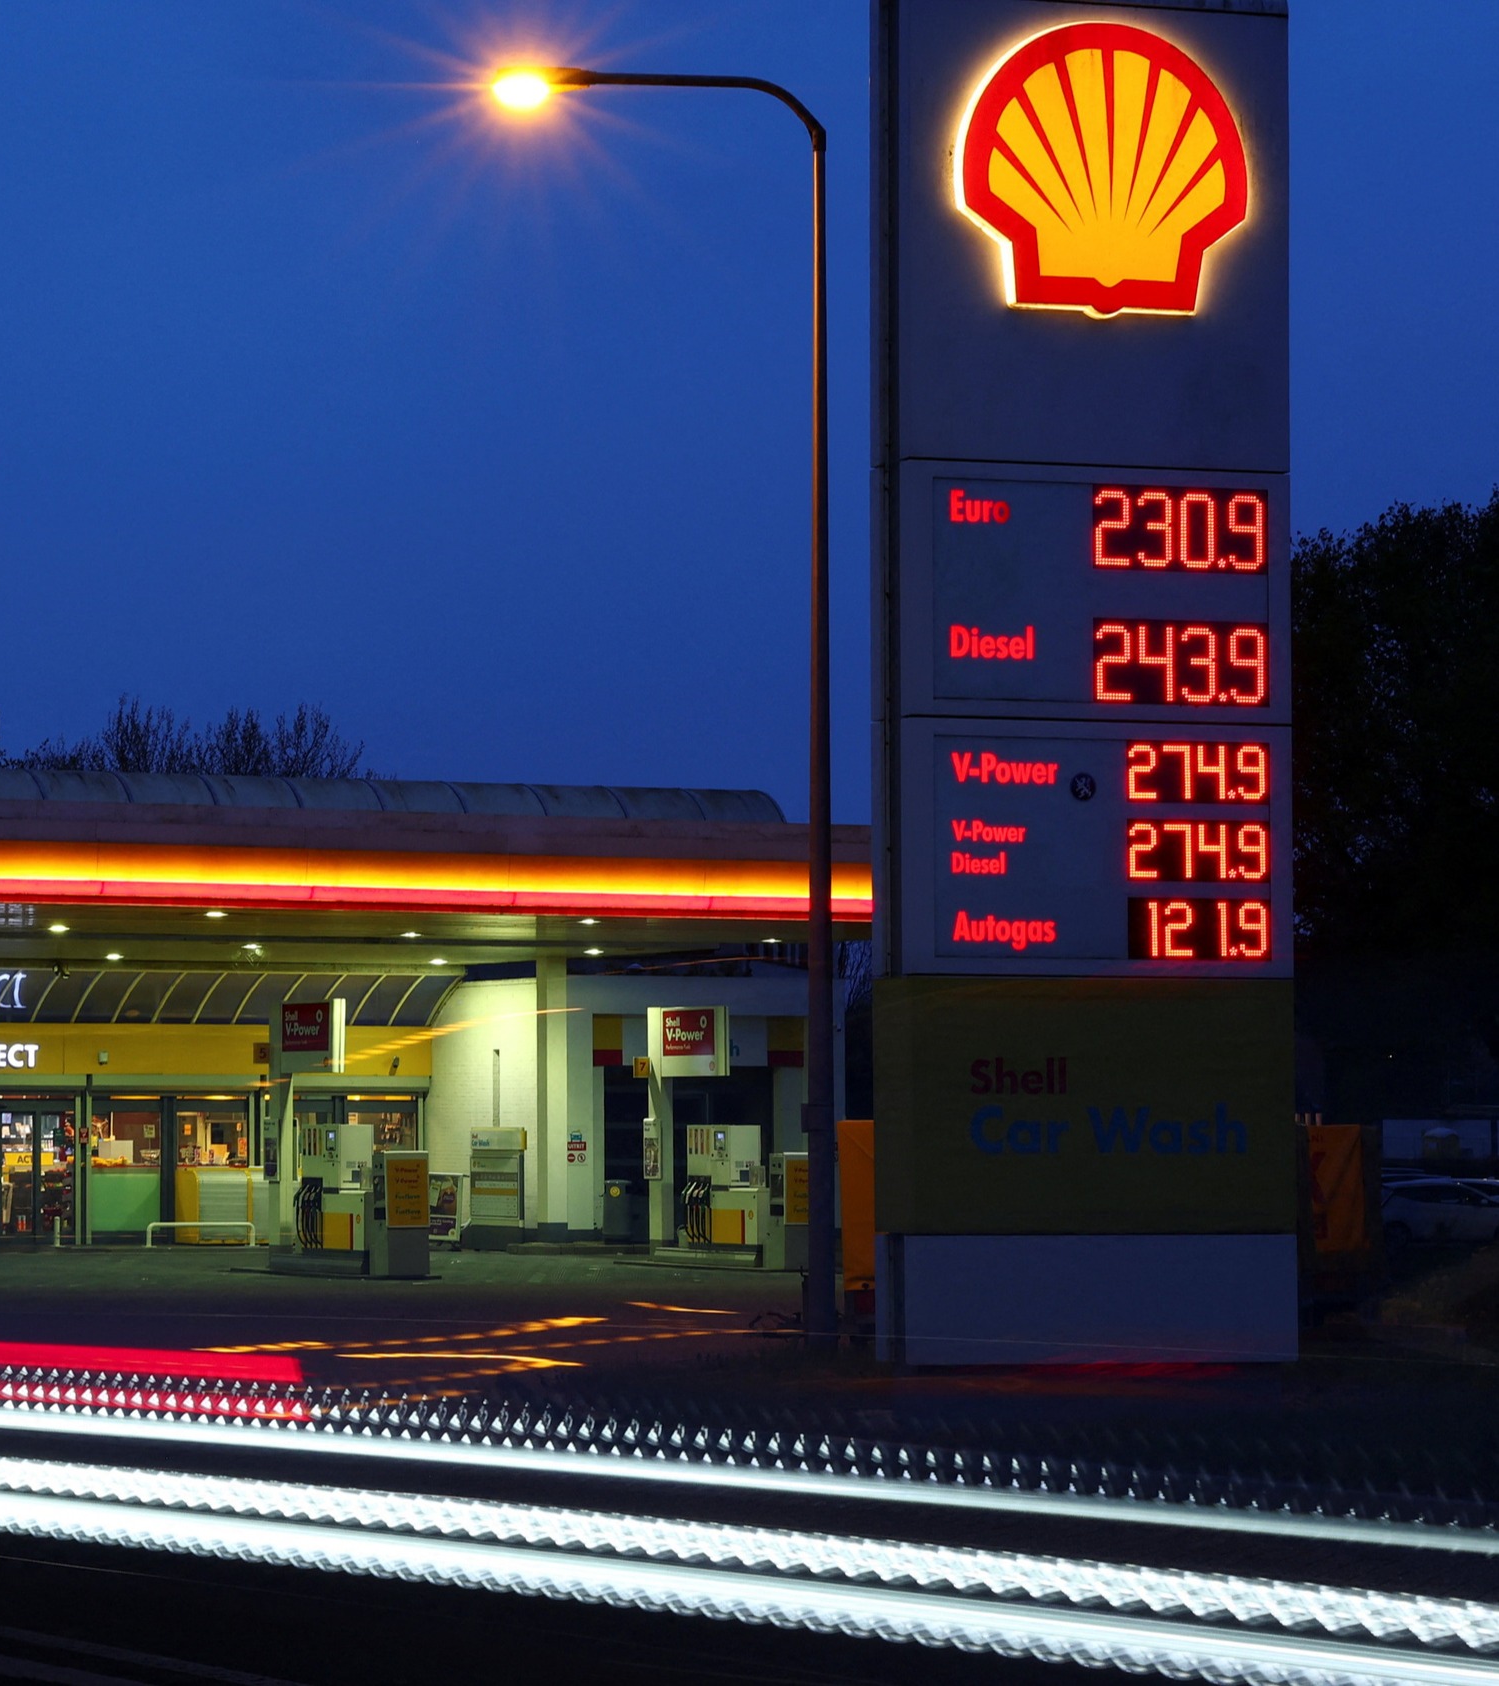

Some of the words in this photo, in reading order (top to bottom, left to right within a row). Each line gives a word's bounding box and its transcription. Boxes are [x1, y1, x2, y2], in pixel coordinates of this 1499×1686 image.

[949, 489, 1010, 523] Euro
[1095, 490, 1264, 571] 230.9
[950, 625, 1035, 660] Diesel
[1096, 625, 1265, 704] 243.9
[951, 752, 1058, 785] V-Power
[1128, 744, 1266, 800] 274.9
[951, 820, 1026, 843] V-Power
[951, 852, 1006, 875] Diesel
[1128, 823, 1267, 879] 274.9
[953, 911, 1057, 950] Autogas
[285, 1010, 298, 1021] Shell
[285, 1022, 320, 1037] V-Power
[665, 1016, 681, 1028] Shell
[665, 1028, 705, 1042] V-Power
[259, 1047, 267, 1059] 5
[639, 1062, 646, 1071] 7
[970, 1057, 1068, 1095] Shell
[970, 1105, 1070, 1154] Car
[1087, 1103, 1248, 1154] Wash
